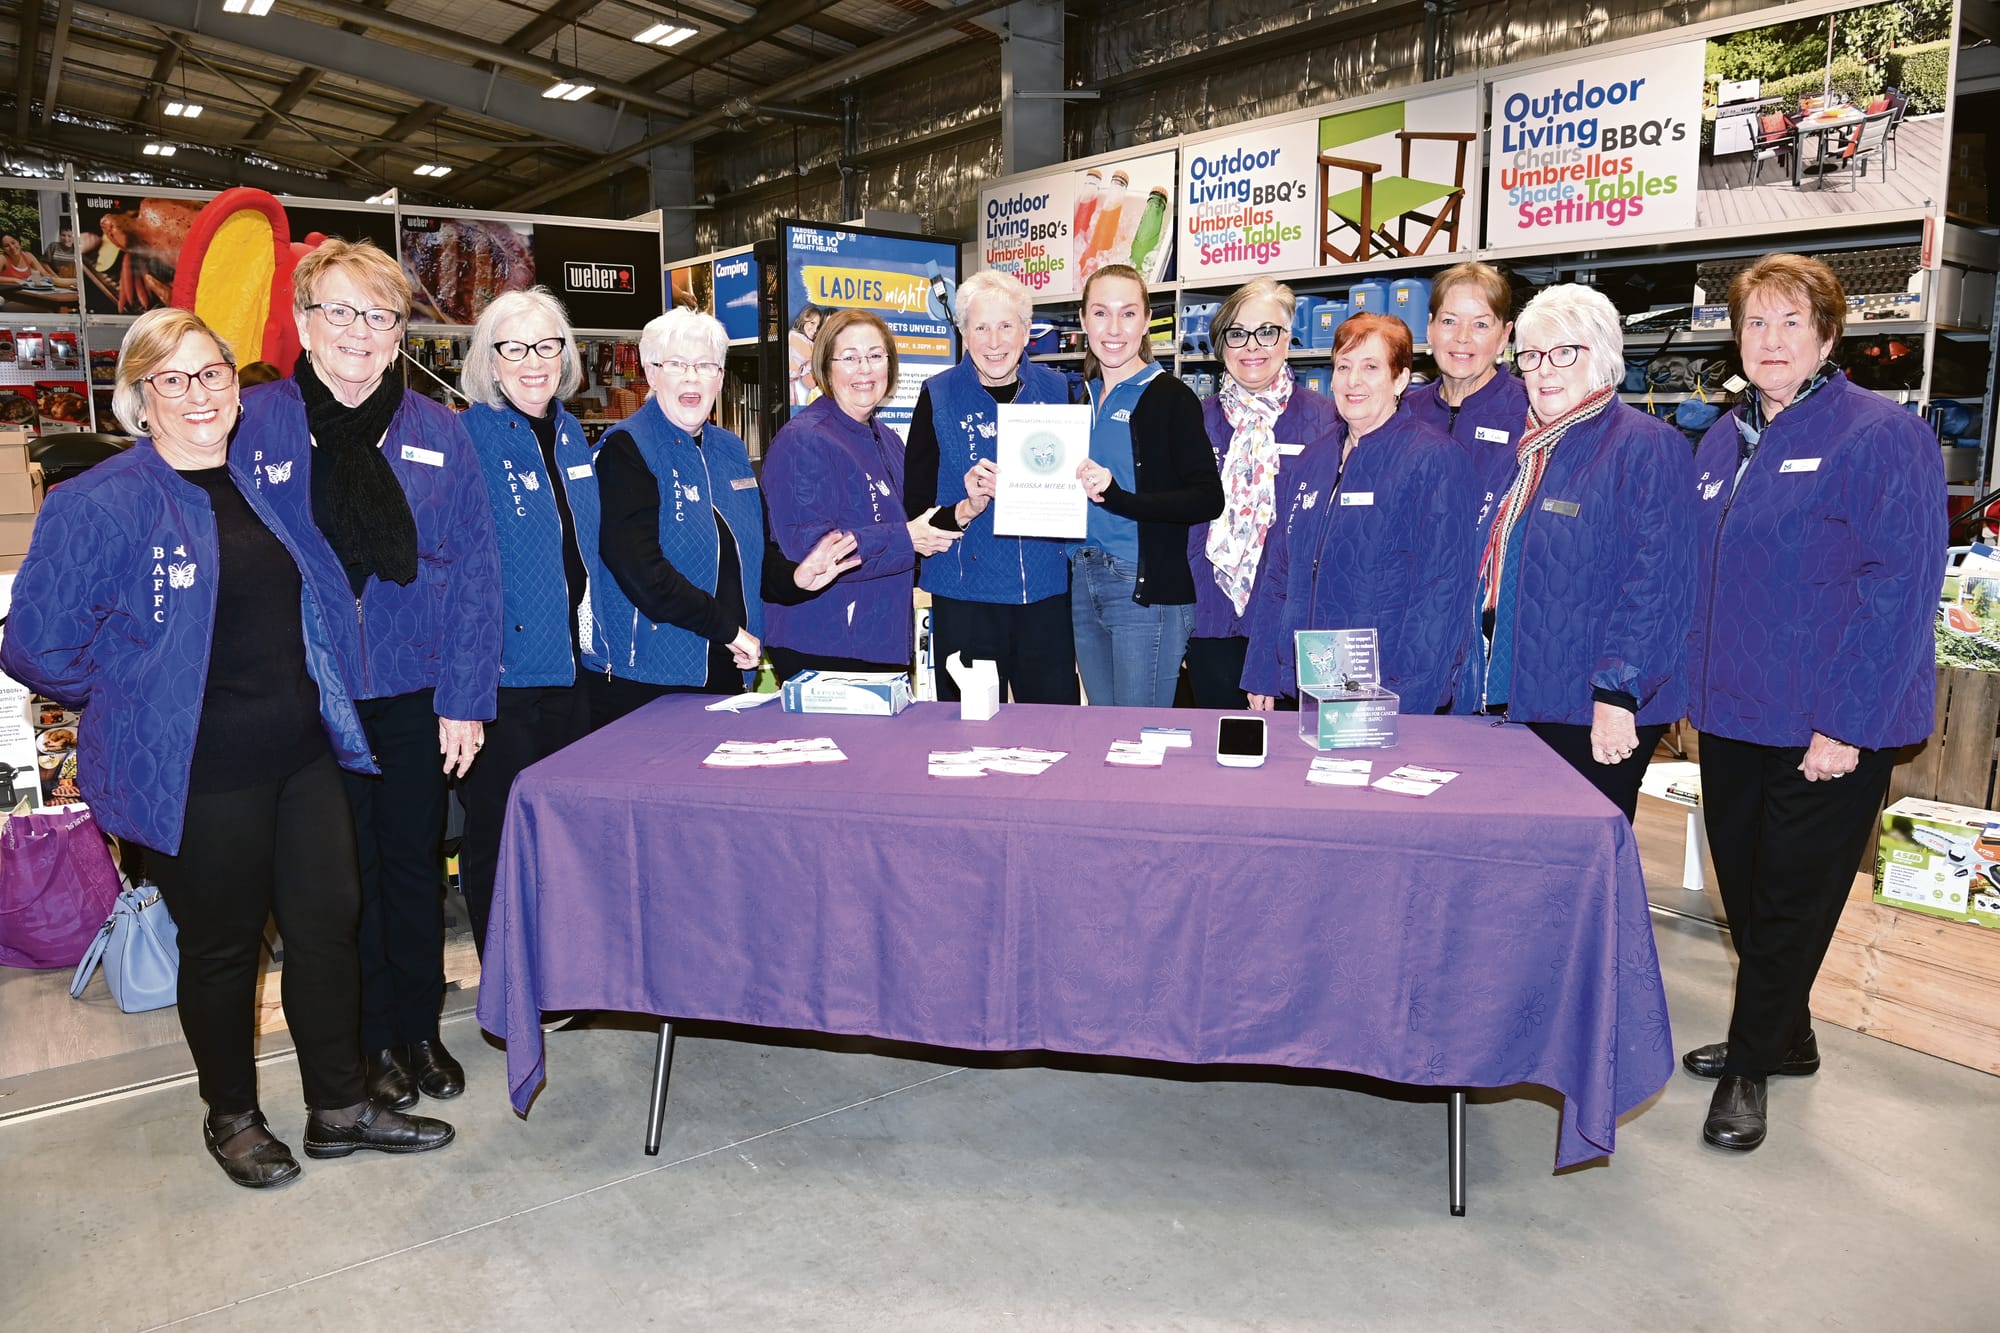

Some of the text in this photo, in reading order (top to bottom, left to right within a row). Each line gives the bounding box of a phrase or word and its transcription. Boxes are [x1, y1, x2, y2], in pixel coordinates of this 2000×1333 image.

[1503, 77, 1646, 123] Outdoor
[1502, 116, 1686, 153] Living BBQ's
[1190, 147, 1280, 180] Outdoor
[1513, 145, 1582, 170] Chairs
[1501, 153, 1633, 190] Umbrellas
[1189, 176, 1306, 206] Living BBQ's
[1508, 170, 1678, 206] Shade Tables
[87, 196, 114, 209] weber
[987, 192, 1050, 219] Outdoor
[1197, 200, 1241, 218] Chairs
[1517, 194, 1644, 229] Settings
[407, 216, 429, 228] weber
[986, 216, 1067, 241] Living BBQ's
[1188, 206, 1273, 234] Umbrellas
[792, 233, 824, 246] MITRE
[826, 236, 839, 247] 10
[991, 236, 1023, 250] Chairs
[1193, 221, 1302, 247] Shade Tables
[792, 243, 839, 254] MIGHTY HELPFUL
[986, 241, 1045, 264] Umbrellas
[1200, 238, 1280, 265] Settings
[569, 263, 617, 289] weber
[715, 259, 749, 279] Camping
[1023, 254, 1065, 273] Tables
[820, 275, 883, 301] LADIES
[884, 279, 926, 314] night
[884, 321, 947, 335] RETS UNVEILED
[896, 411, 913, 419] FROM
[966, 414, 978, 461] BAFFC
[502, 459, 526, 516] BAFFC
[672, 468, 684, 521] BAFFC
[865, 472, 881, 522] BAFFC
[1008, 481, 1042, 489] BAROSSA
[1044, 482, 1065, 490] MITRE
[1287, 482, 1307, 535] BAFFC
[152, 546, 166, 623] BAFFC
